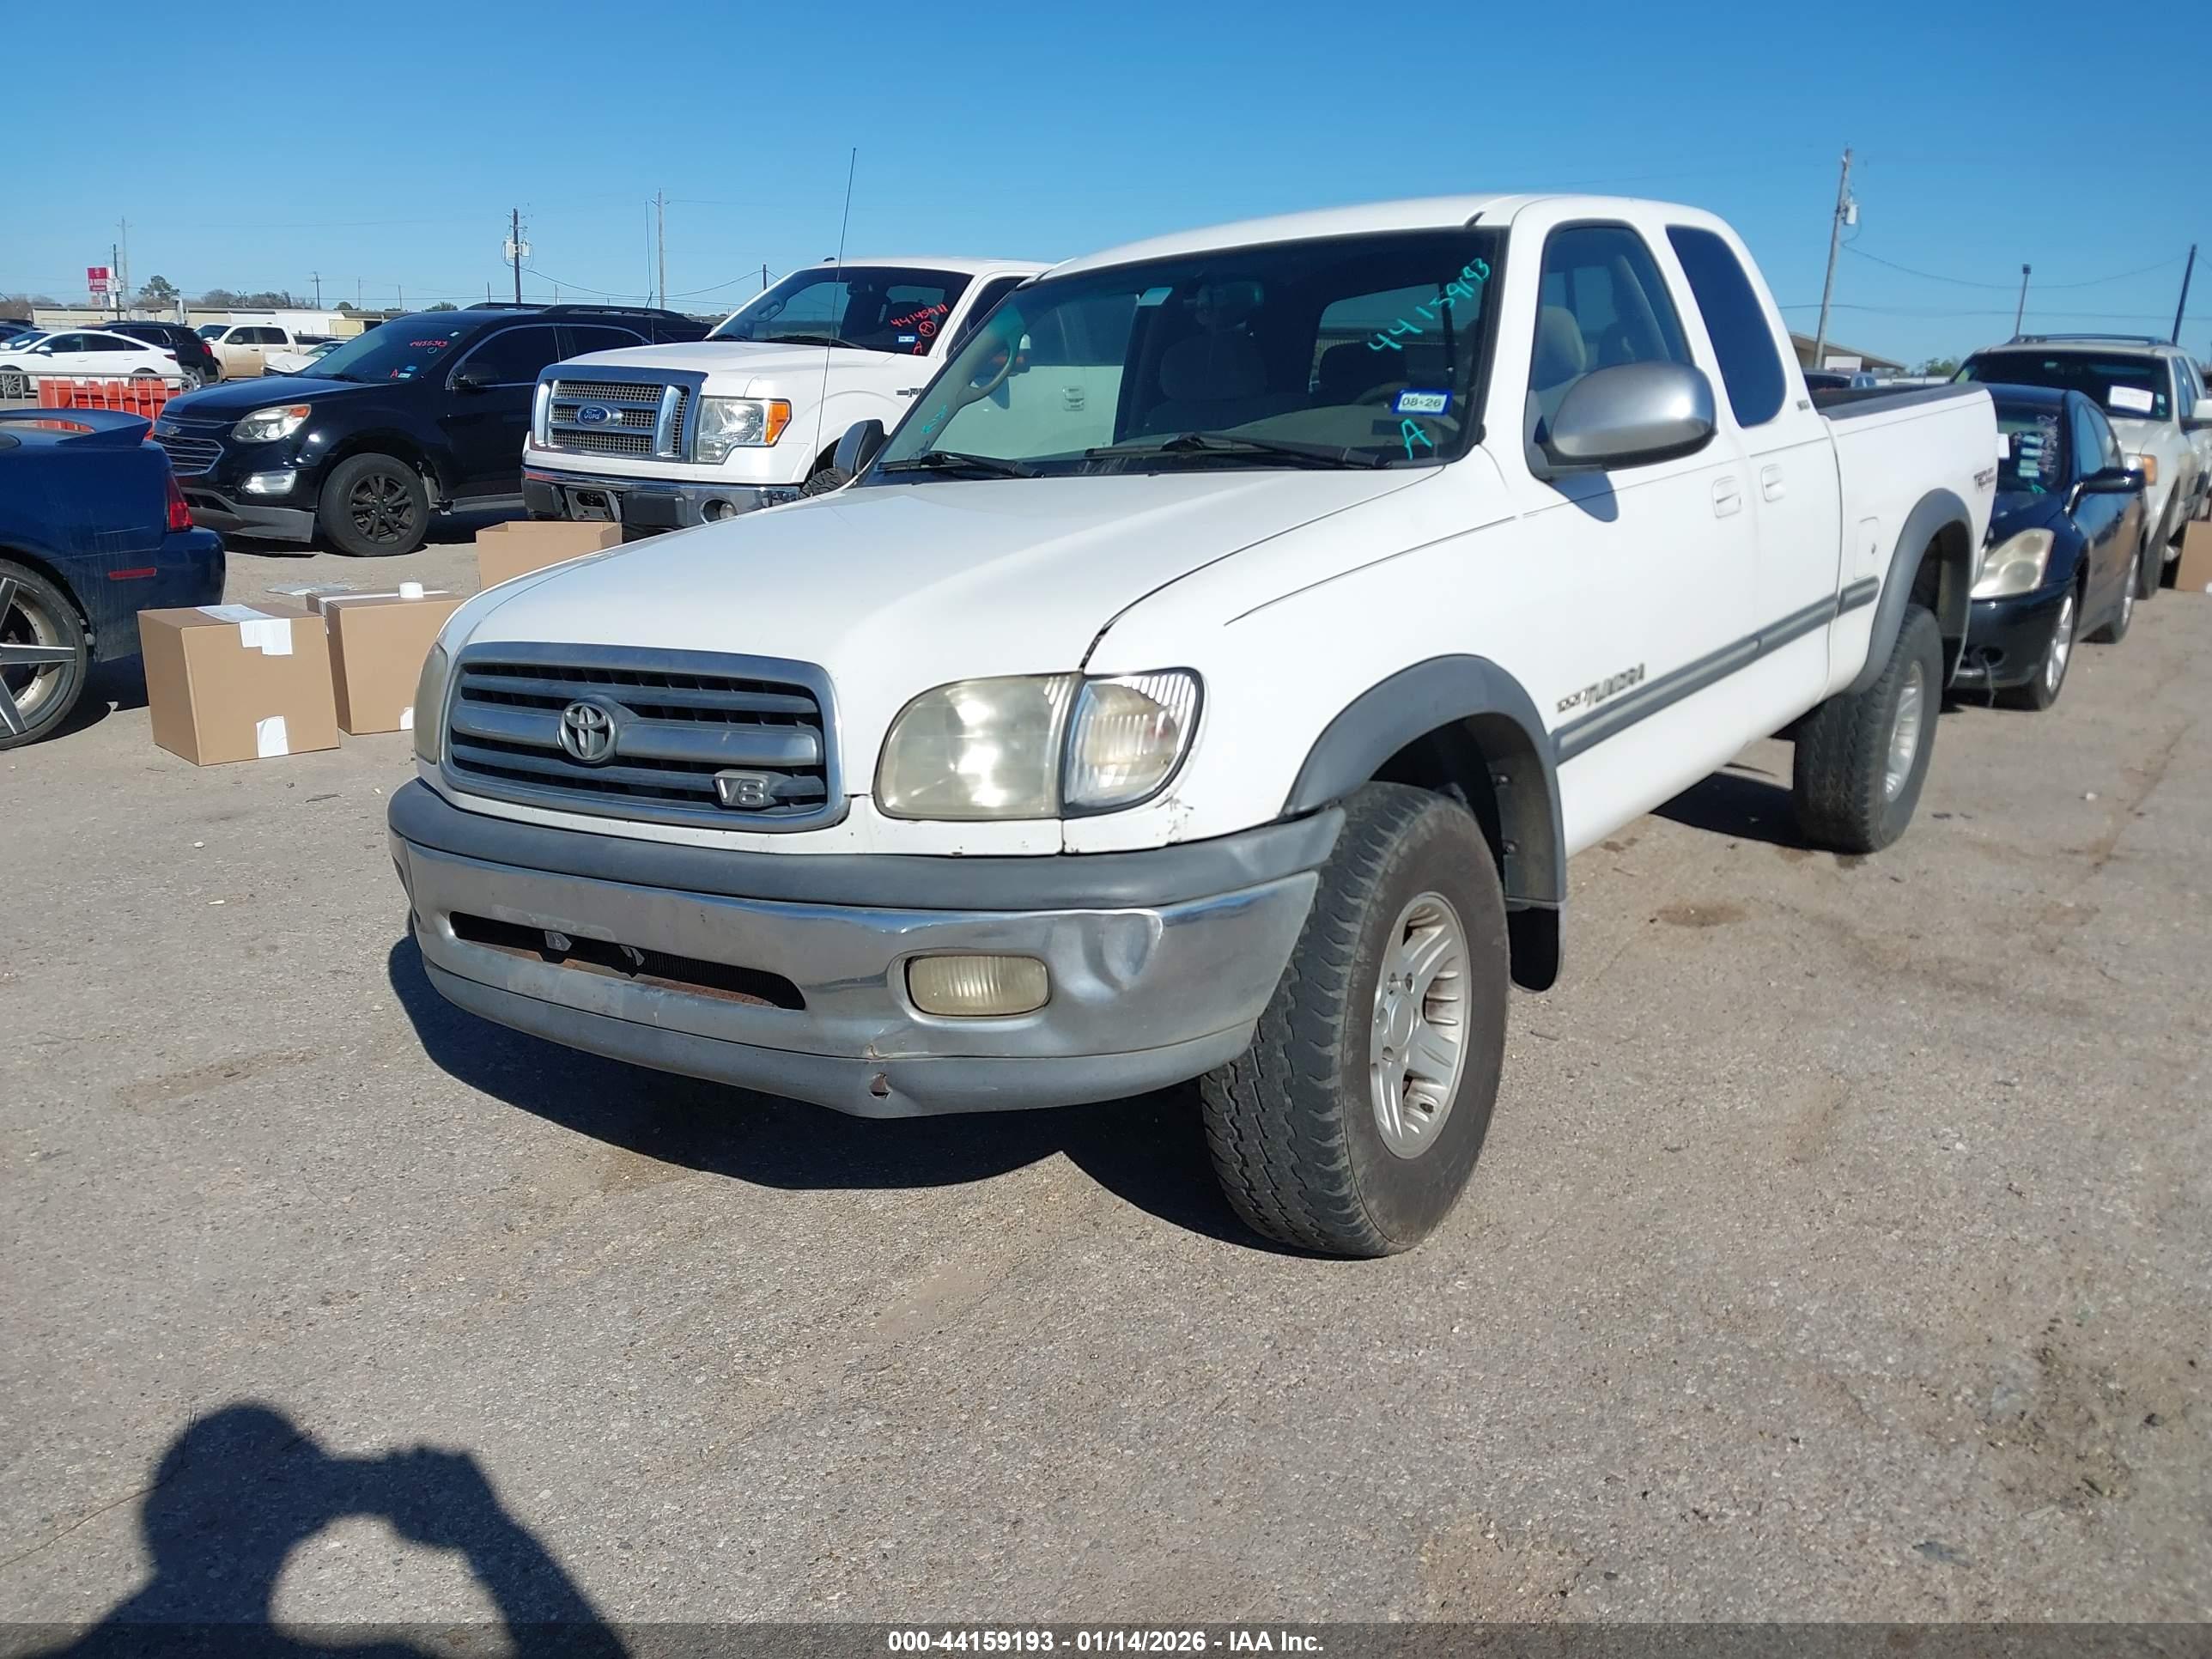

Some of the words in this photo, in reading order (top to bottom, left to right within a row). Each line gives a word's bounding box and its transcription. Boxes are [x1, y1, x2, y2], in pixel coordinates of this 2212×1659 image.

[890, 303, 949, 326] 44145911
[1368, 258, 1490, 350] 44159193
[913, 340, 922, 354] A
[584, 408, 601, 420] Ford
[1401, 418, 1432, 460] A
[717, 776, 765, 805] V8
